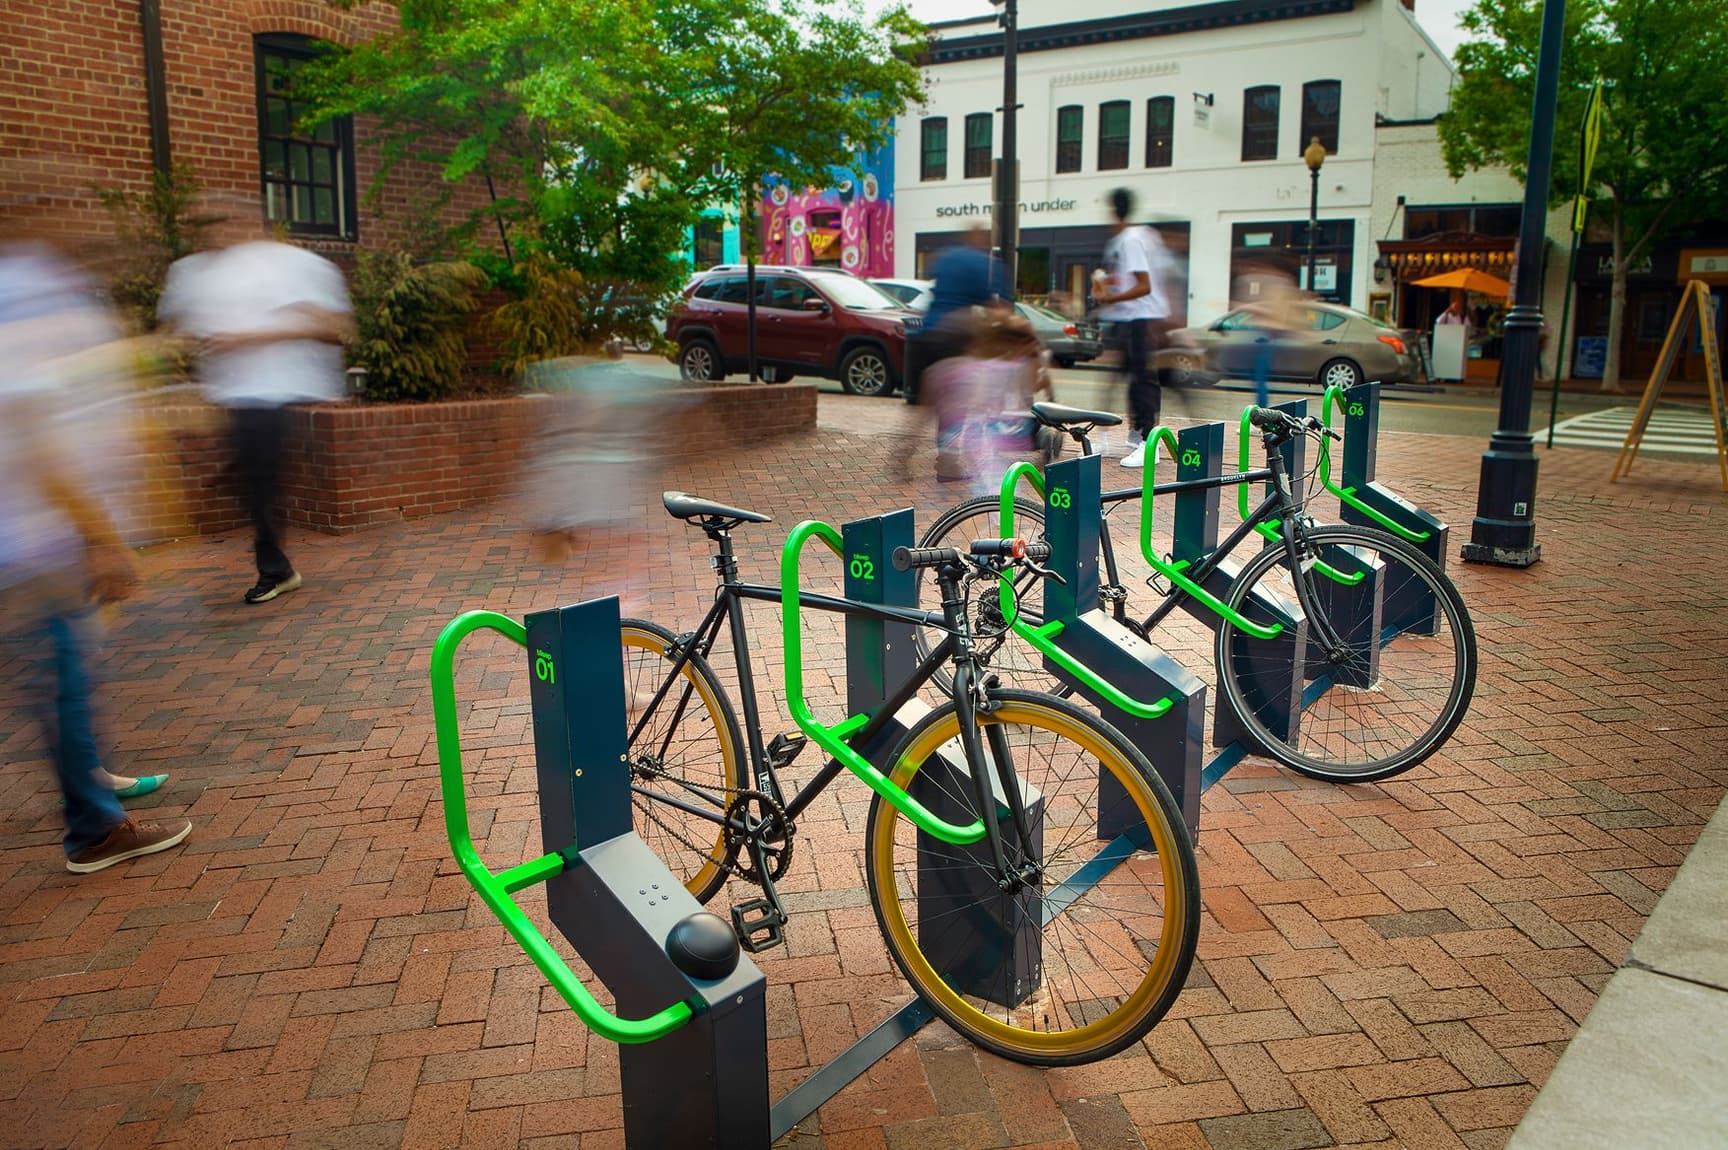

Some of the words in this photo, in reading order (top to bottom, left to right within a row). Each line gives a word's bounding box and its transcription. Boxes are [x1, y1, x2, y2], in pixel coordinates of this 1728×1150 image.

[936, 202, 979, 217] south
[982, 203, 1028, 214] mn
[1031, 198, 1077, 212] under
[1349, 405, 1364, 416] 06
[1182, 453, 1201, 467] 04
[1050, 492, 1071, 508] 03
[850, 560, 874, 580] 02
[536, 658, 555, 684] 01
